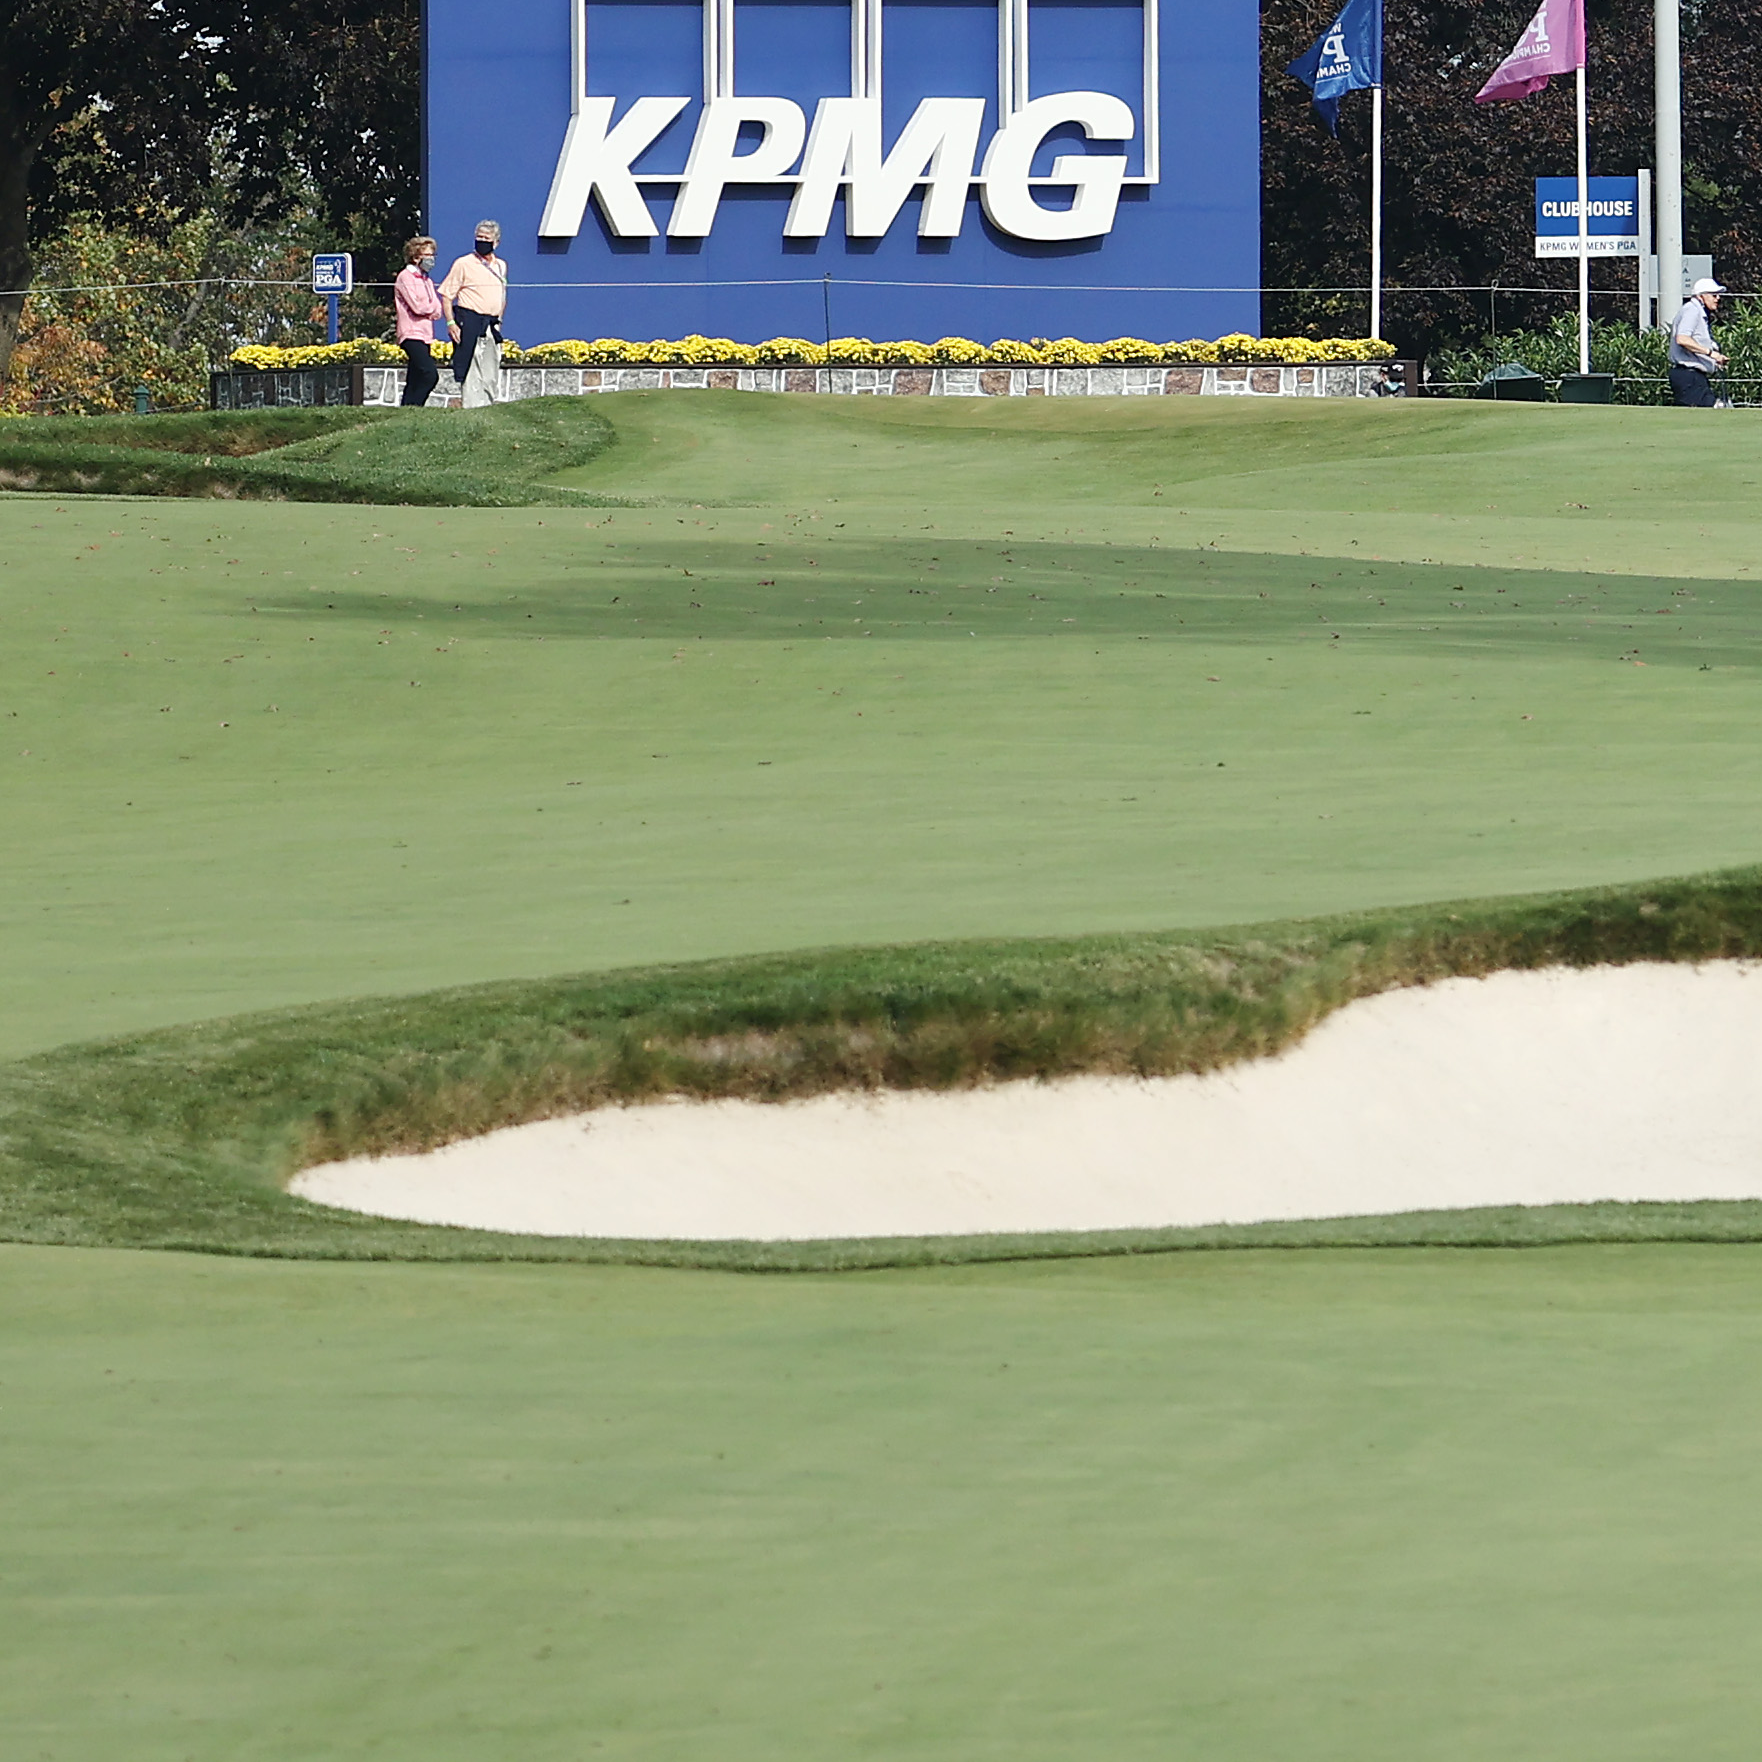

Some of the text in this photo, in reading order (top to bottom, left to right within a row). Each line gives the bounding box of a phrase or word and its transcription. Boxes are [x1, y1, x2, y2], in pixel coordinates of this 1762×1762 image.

[538, 91, 1134, 241] KPMG
[1542, 200, 1633, 217] CLUBHOUSE
[1540, 241, 1637, 251] KPMG WMEN'S PGA
[316, 274, 342, 284] PGA
